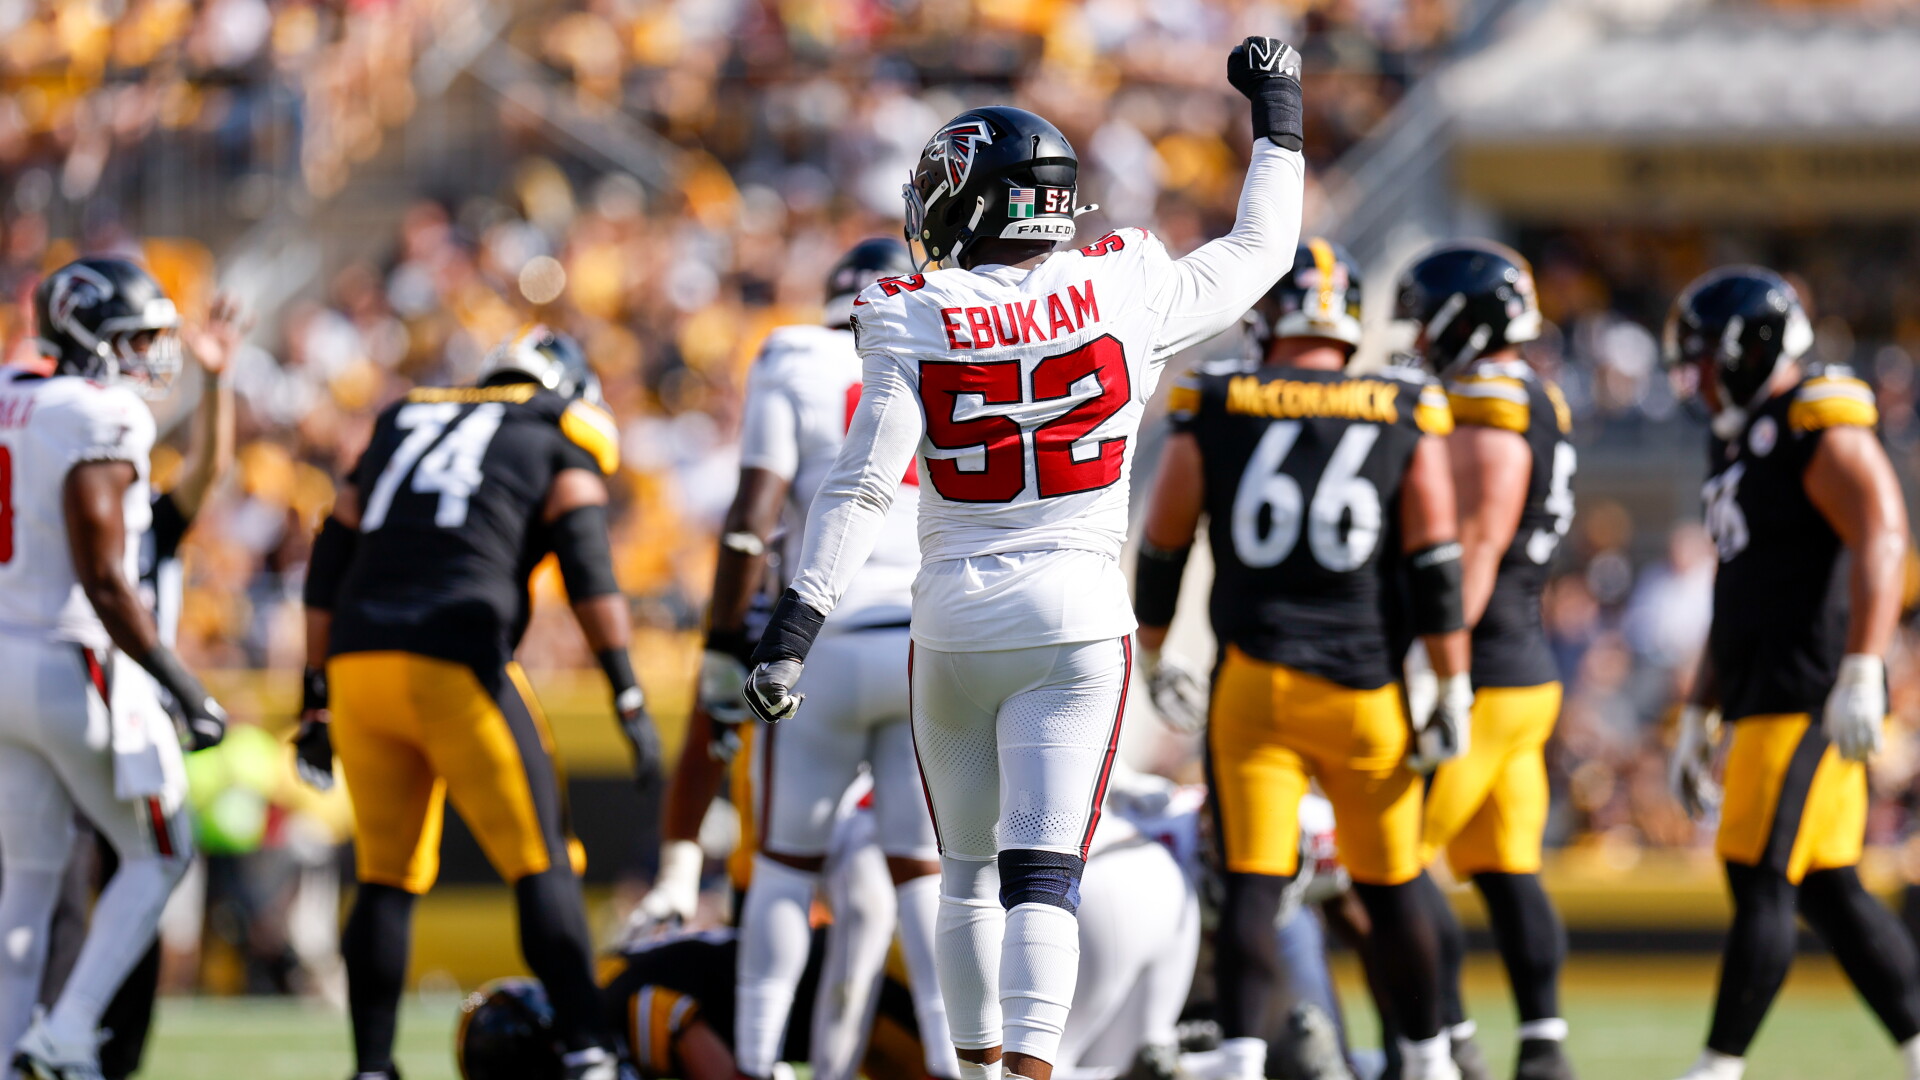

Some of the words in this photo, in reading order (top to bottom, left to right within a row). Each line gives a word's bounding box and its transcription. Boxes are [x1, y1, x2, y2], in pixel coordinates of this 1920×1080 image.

[1045, 188, 1070, 213] 52
[1017, 224, 1074, 236] FALCO
[1080, 230, 1125, 257] 5
[877, 273, 926, 297] 2
[940, 279, 1100, 350] EBUKAM
[918, 332, 1132, 503] 52
[360, 401, 506, 534] 74
[1230, 420, 1382, 573] 66
